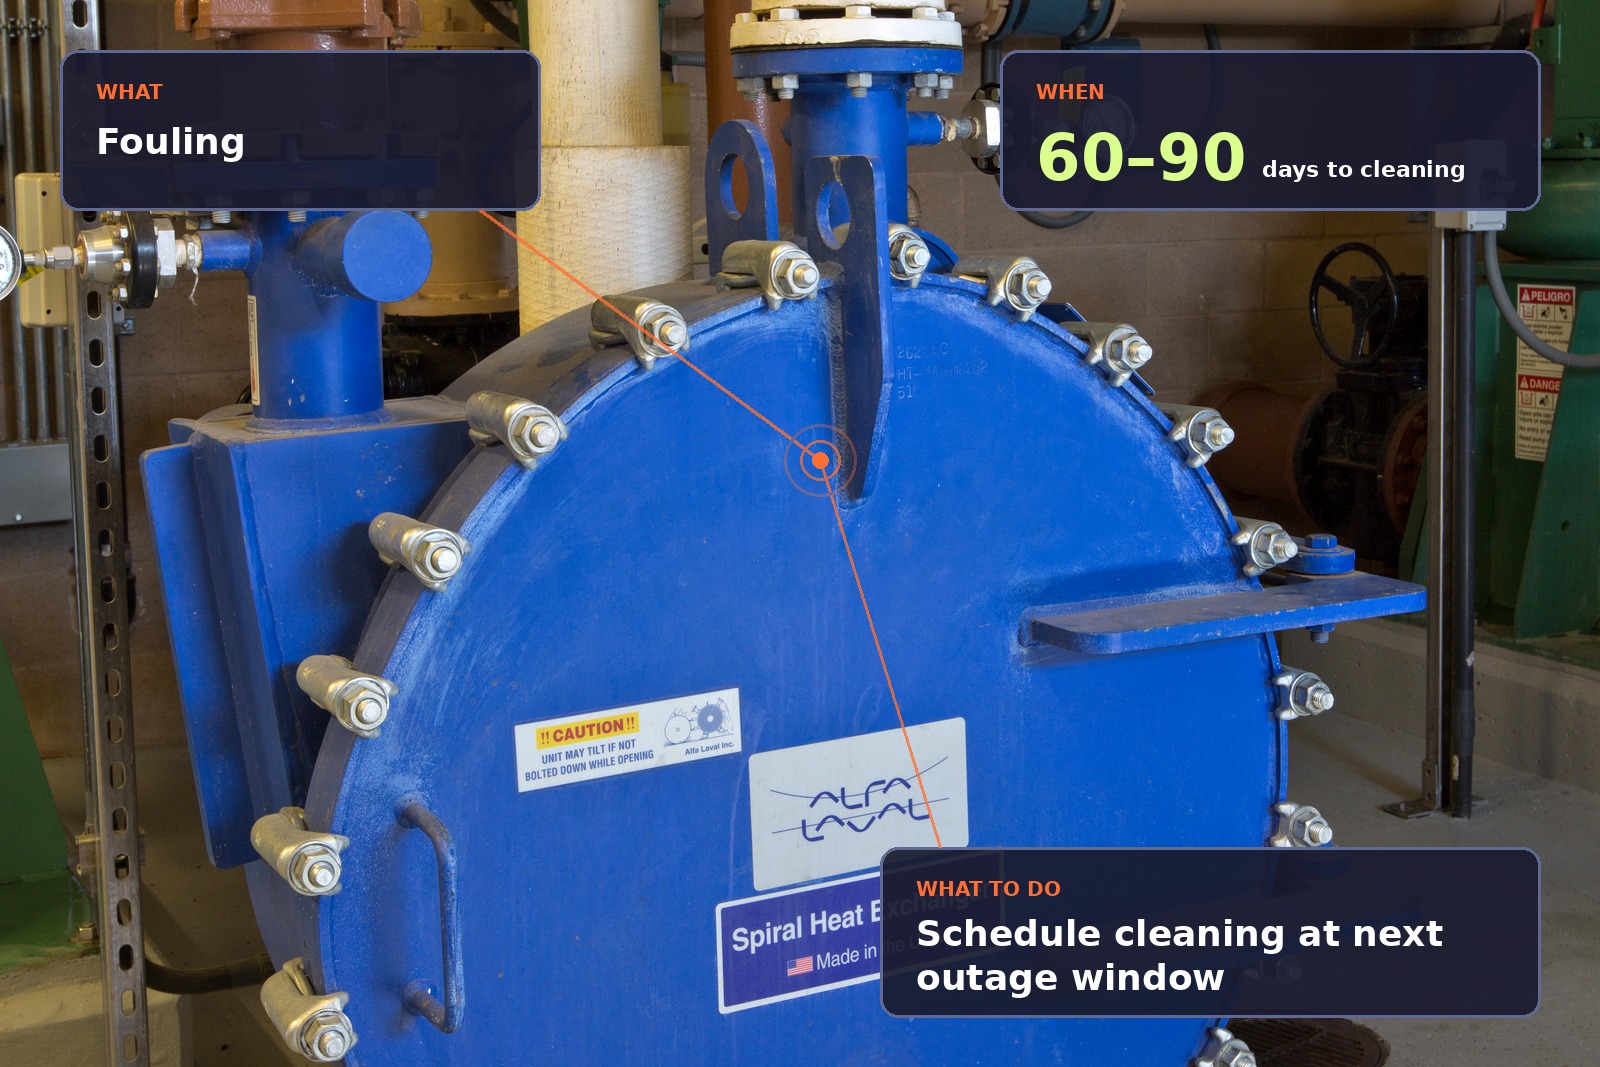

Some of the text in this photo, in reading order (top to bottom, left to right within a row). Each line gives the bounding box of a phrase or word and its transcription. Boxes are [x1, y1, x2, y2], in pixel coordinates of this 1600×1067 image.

[1531, 291, 1571, 303] PELIGRO
[1529, 378, 1561, 391] DANGE
[552, 718, 624, 743] CAUTION
[541, 739, 636, 764] UNIT MAY TILT IF NOT
[684, 741, 735, 755] Alfa Laval Inc.
[525, 749, 654, 781] BOLTED DOWN WHILE OPENING
[809, 777, 912, 810] ALFA
[801, 798, 930, 842] LAVAL
[732, 915, 803, 955] Spiral
[810, 904, 864, 936] Heat
[816, 948, 860, 971] Made
[864, 943, 878, 960] in
